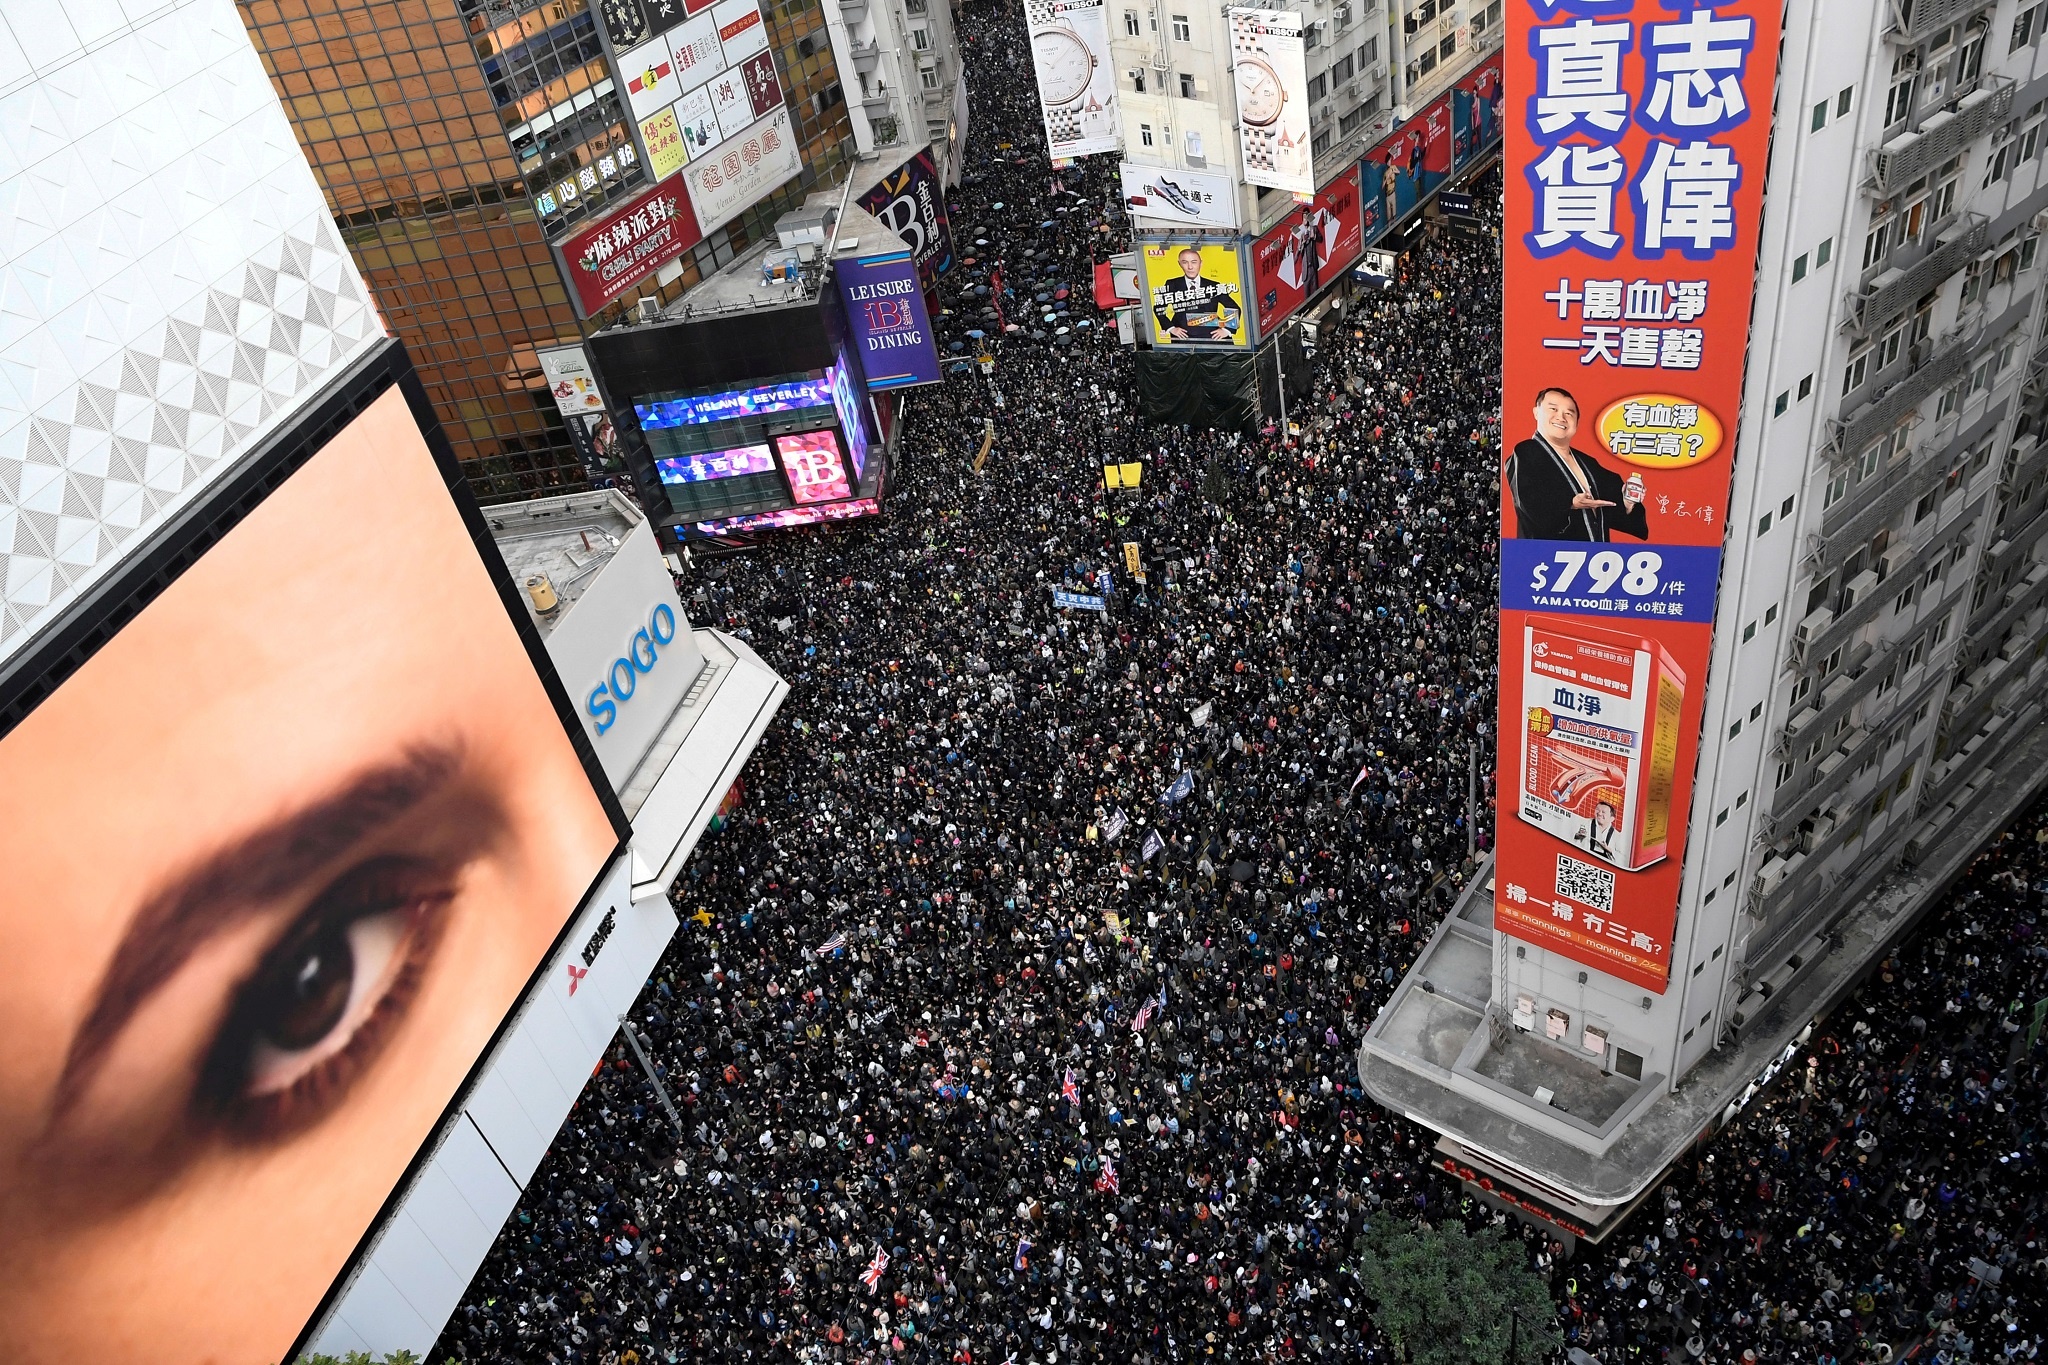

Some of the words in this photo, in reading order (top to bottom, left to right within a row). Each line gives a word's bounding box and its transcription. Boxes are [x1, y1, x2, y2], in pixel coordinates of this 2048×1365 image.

[1064, 0, 1098, 10] TISSOT
[1266, 27, 1299, 37] TISSOT
[644, 115, 673, 141] 傷心
[1534, 0, 1630, 249] 真貨
[702, 127, 782, 192] 花園餐廳
[738, 175, 762, 198] Garden
[915, 180, 939, 245] 金百利
[593, 196, 667, 263] 麻辣派對
[601, 250, 634, 280] CHILI
[633, 224, 671, 261] PARTY
[850, 279, 914, 300] LEISURE
[1153, 282, 1238, 305] 馬百良安宮牛黃丸
[867, 331, 922, 350] DINING
[1543, 326, 1703, 369] 一天售罄
[1624, 403, 1698, 428] 有血淨
[1635, 601, 1684, 616] 60粒裝
[586, 604, 676, 736] SOGO
[1553, 687, 1602, 716] 血淨
[1529, 744, 1539, 766] CLEAN
[1528, 767, 1538, 791] BLOOD
[1506, 882, 1574, 922] 掃一掃
[1522, 913, 1572, 938] mannings
[1586, 939, 1637, 963] mannings
